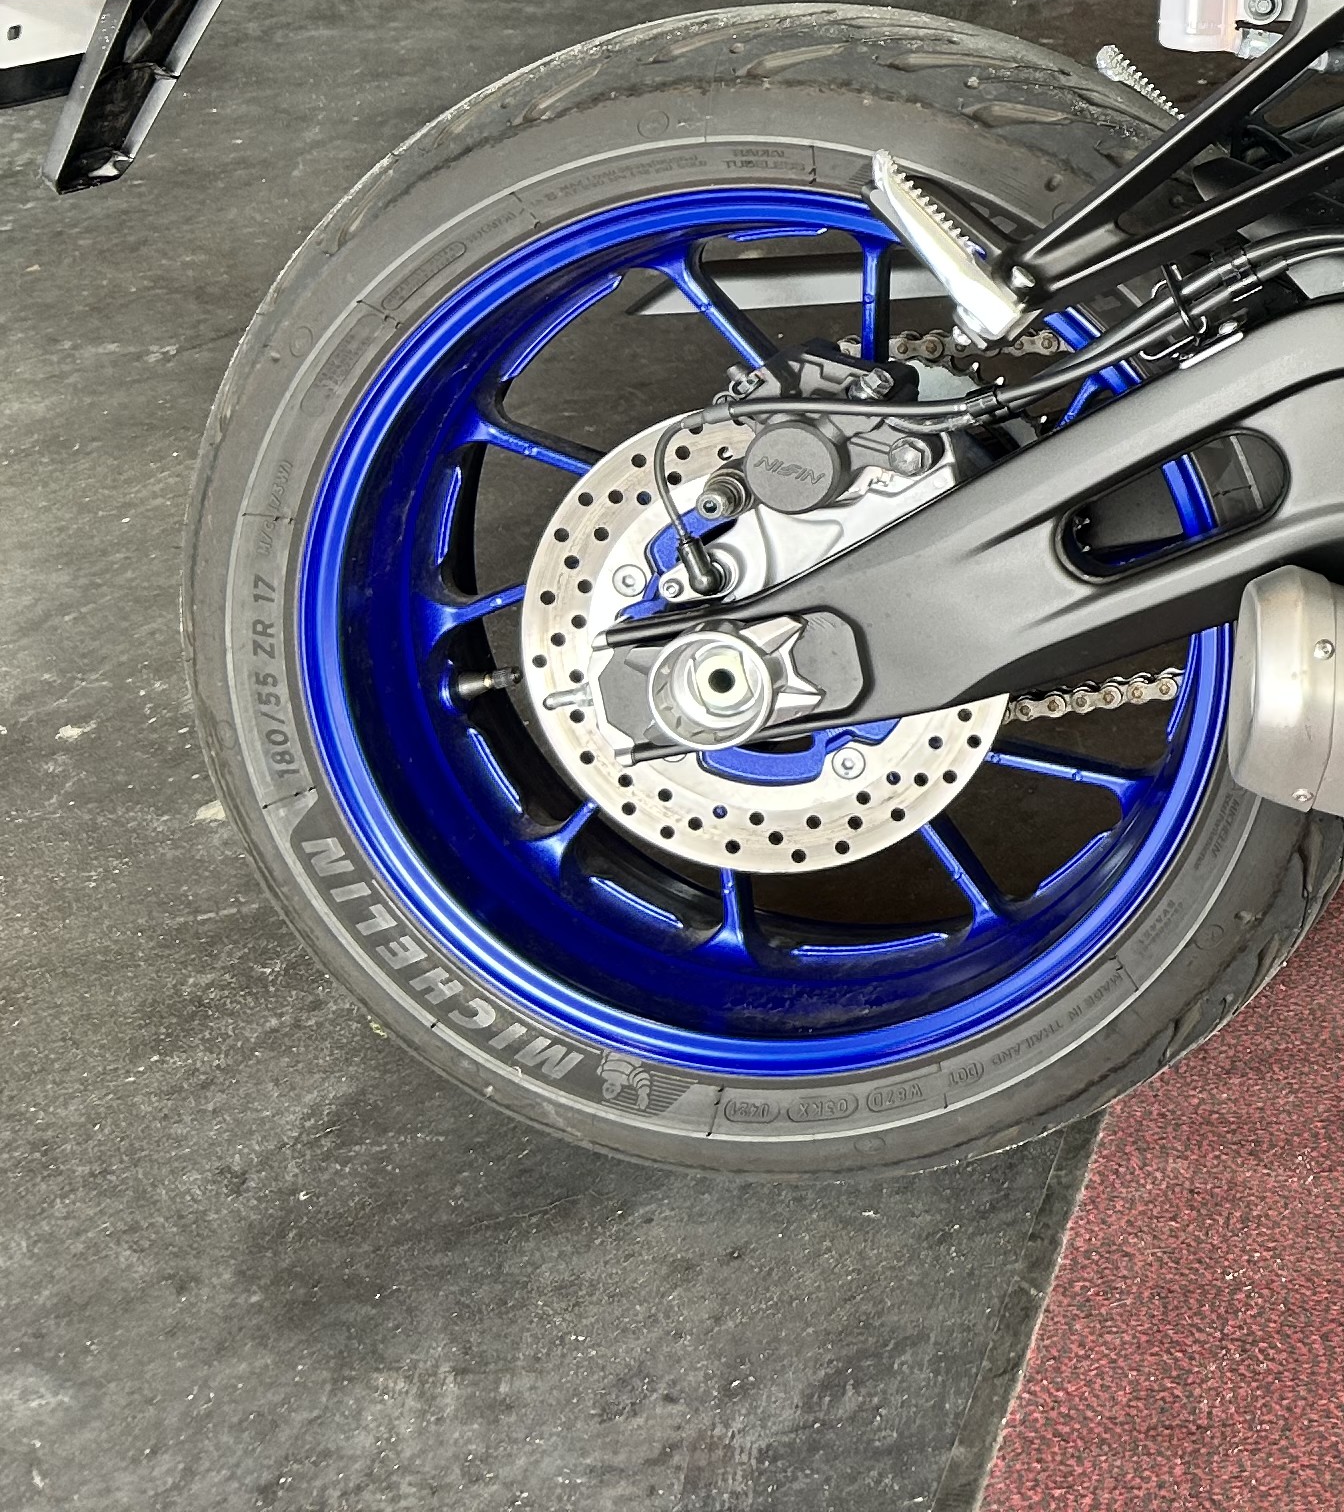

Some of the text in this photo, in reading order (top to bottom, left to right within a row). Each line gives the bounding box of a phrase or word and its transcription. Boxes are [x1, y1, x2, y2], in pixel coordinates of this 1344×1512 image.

[753, 455, 826, 485] NISSIN
[253, 576, 277, 603] 17
[252, 620, 277, 660] ZR
[254, 671, 299, 779] 180/55
[302, 837, 585, 1081] MICHELIN
[949, 1062, 981, 1085] DOT
[727, 1099, 771, 1121] 0421
